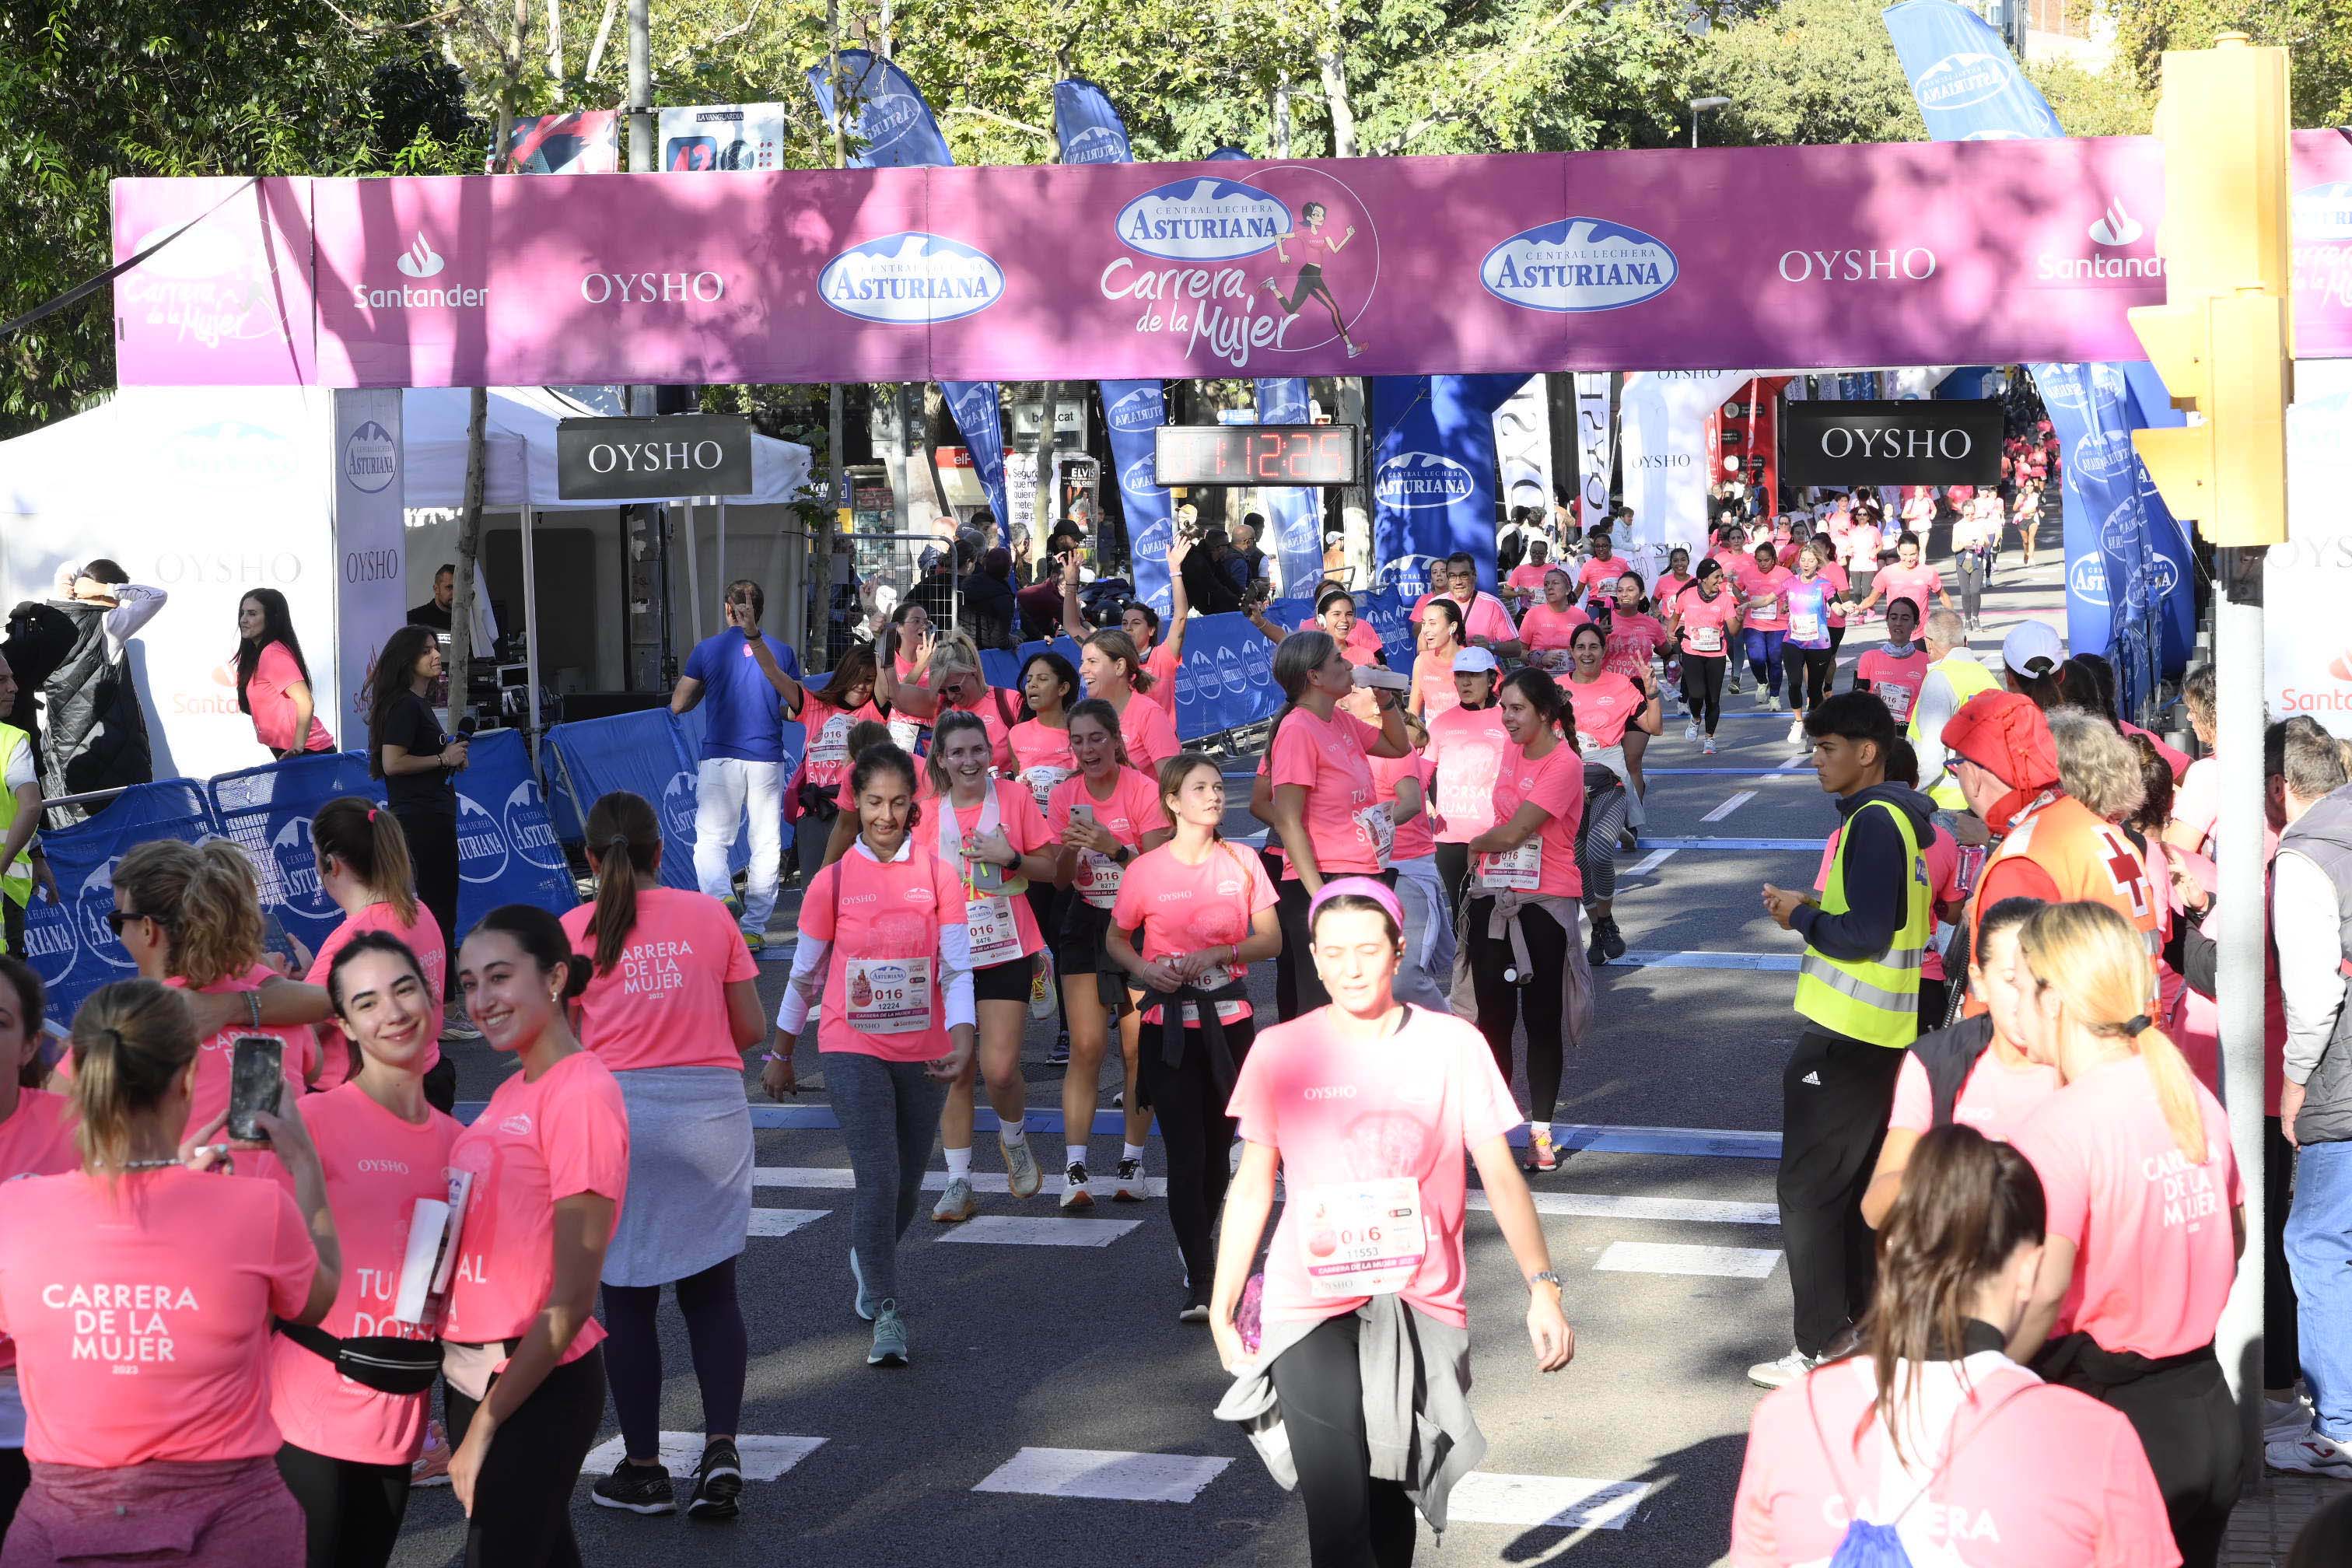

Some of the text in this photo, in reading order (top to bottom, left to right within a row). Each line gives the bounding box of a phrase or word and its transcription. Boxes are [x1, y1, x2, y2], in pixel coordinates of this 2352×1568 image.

[697, 111, 744, 121] LA VANGUARDIA
[1157, 205, 1273, 215] CENTRAL LECHERA
[1129, 209, 1279, 240] ASTURIANA
[1526, 248, 1656, 261] CENTRAL LECHERA
[1780, 247, 1936, 282] OYSHO
[1100, 257, 1246, 300] Carrera
[1495, 254, 1663, 289] ASTURIANA
[580, 271, 725, 304] OYSHO
[833, 267, 991, 300] ASTURIANA
[353, 284, 489, 309] Santander
[1136, 295, 1300, 368] de la Mujer
[1657, 369, 1721, 380] OYSHO
[1821, 428, 1972, 459] OYSHO
[349, 447, 394, 475] ASTURIANA
[589, 440, 723, 473] OYSHO
[1632, 453, 1691, 468] OYSHO
[1071, 467, 1095, 478] ELVIS
[1379, 474, 1467, 495] ASTURIANA
[155, 551, 303, 584] OYSHO
[347, 549, 398, 583] OYSHO
[173, 692, 240, 715] Santa
[809, 772, 837, 784] SUMA
[1034, 784, 1049, 793] 016
[515, 817, 556, 849] ASTUR
[457, 831, 506, 862] TURIANA
[1501, 852, 1518, 860] 016
[1095, 872, 1119, 881] 016
[842, 894, 877, 906] OYSHO
[1159, 891, 1192, 902] OYSHO
[23, 923, 72, 957] RIANA
[970, 924, 993, 936] 016
[622, 940, 693, 964] ARRERA
[625, 956, 679, 978] DE LA
[624, 973, 683, 995] MUJER
[875, 989, 902, 1000] 016
[1304, 1087, 1358, 1101] OYSHO
[358, 1159, 410, 1174] OYSHO
[2164, 1168, 2212, 1200] DE LA
[2164, 1191, 2218, 1227] MUJER
[1341, 1227, 1381, 1244] 016
[1347, 1247, 1379, 1258] 11553
[1318, 1263, 1350, 1274] CARRERA
[1350, 1262, 1361, 1271] DE
[356, 1269, 394, 1300] TU
[42, 1283, 199, 1311] CARRERA
[74, 1311, 169, 1335] DE LA
[72, 1336, 175, 1362] MUJER
[112, 1364, 138, 1375] 2023
[1822, 1494, 2001, 1543] CAERA
